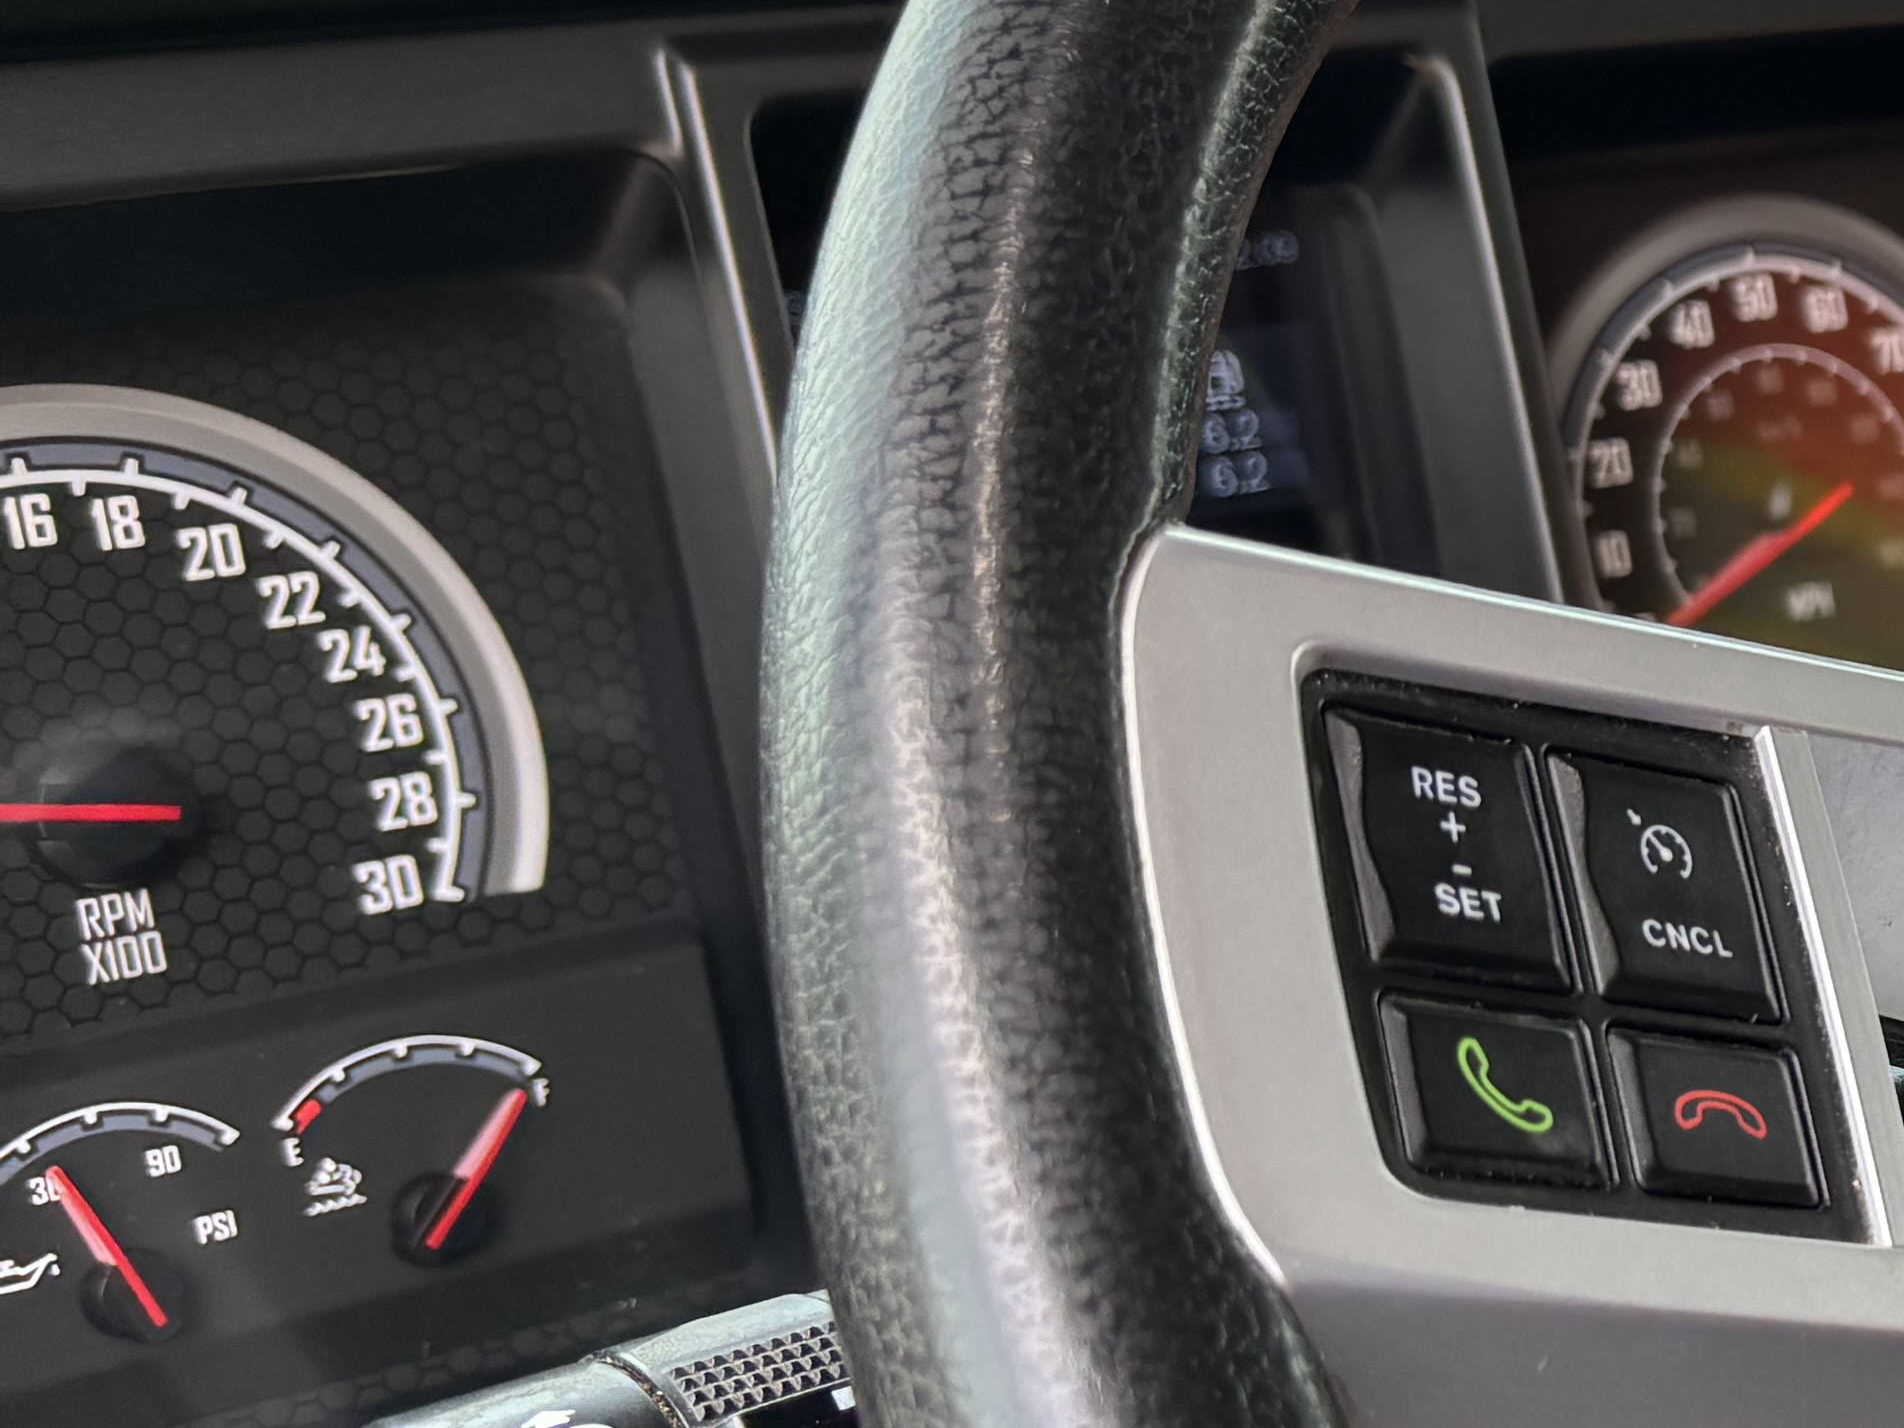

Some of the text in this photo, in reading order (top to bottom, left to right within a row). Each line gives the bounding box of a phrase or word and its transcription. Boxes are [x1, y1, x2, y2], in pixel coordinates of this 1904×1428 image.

[1729, 272, 1778, 322] 50
[1669, 299, 1715, 350] 40
[1616, 359, 1664, 411] 30
[1587, 437, 1634, 488] 20
[3, 493, 57, 550] 16
[91, 495, 145, 551] 18
[176, 523, 246, 581] 20
[1598, 530, 1633, 578] 10
[256, 572, 326, 629] 22
[317, 627, 387, 684] 24
[352, 692, 424, 752] 26
[367, 771, 438, 832] 28
[1411, 766, 1482, 809] RES
[352, 854, 424, 915] 30
[1434, 883, 1502, 923] SET
[76, 888, 154, 940] RPM
[1642, 918, 1734, 958] CNCL
[80, 930, 167, 985] X100
[529, 1077, 550, 1107] F
[145, 1144, 182, 1177] 90
[282, 1136, 304, 1167] E
[194, 1209, 239, 1244] PSI
